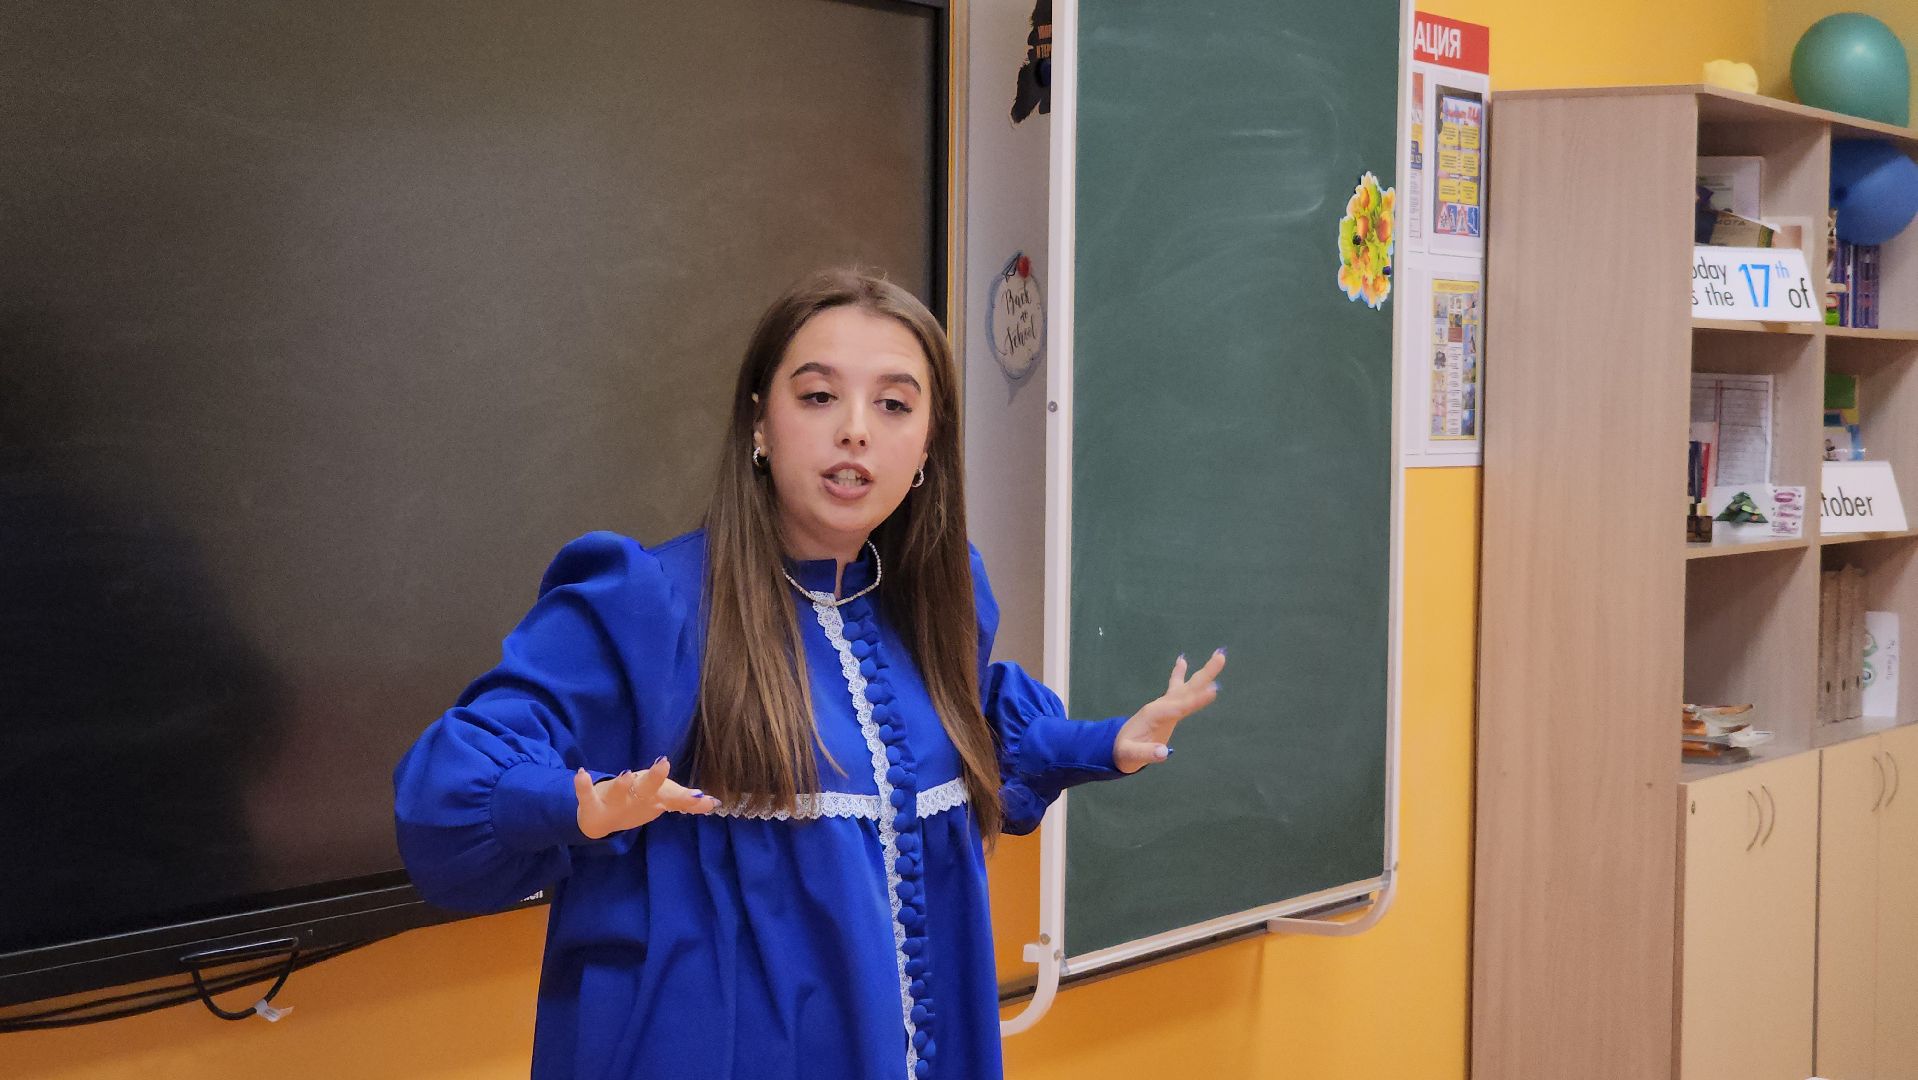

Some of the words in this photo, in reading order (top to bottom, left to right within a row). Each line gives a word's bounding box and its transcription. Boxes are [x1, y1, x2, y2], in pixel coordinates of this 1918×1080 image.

[1415, 21, 1461, 61] АЦИЯ
[1003, 282, 1032, 315] Back
[1705, 282, 1735, 306] the
[1788, 277, 1810, 308] of
[1005, 315, 1036, 355] School
[1821, 486, 1873, 516] tober
